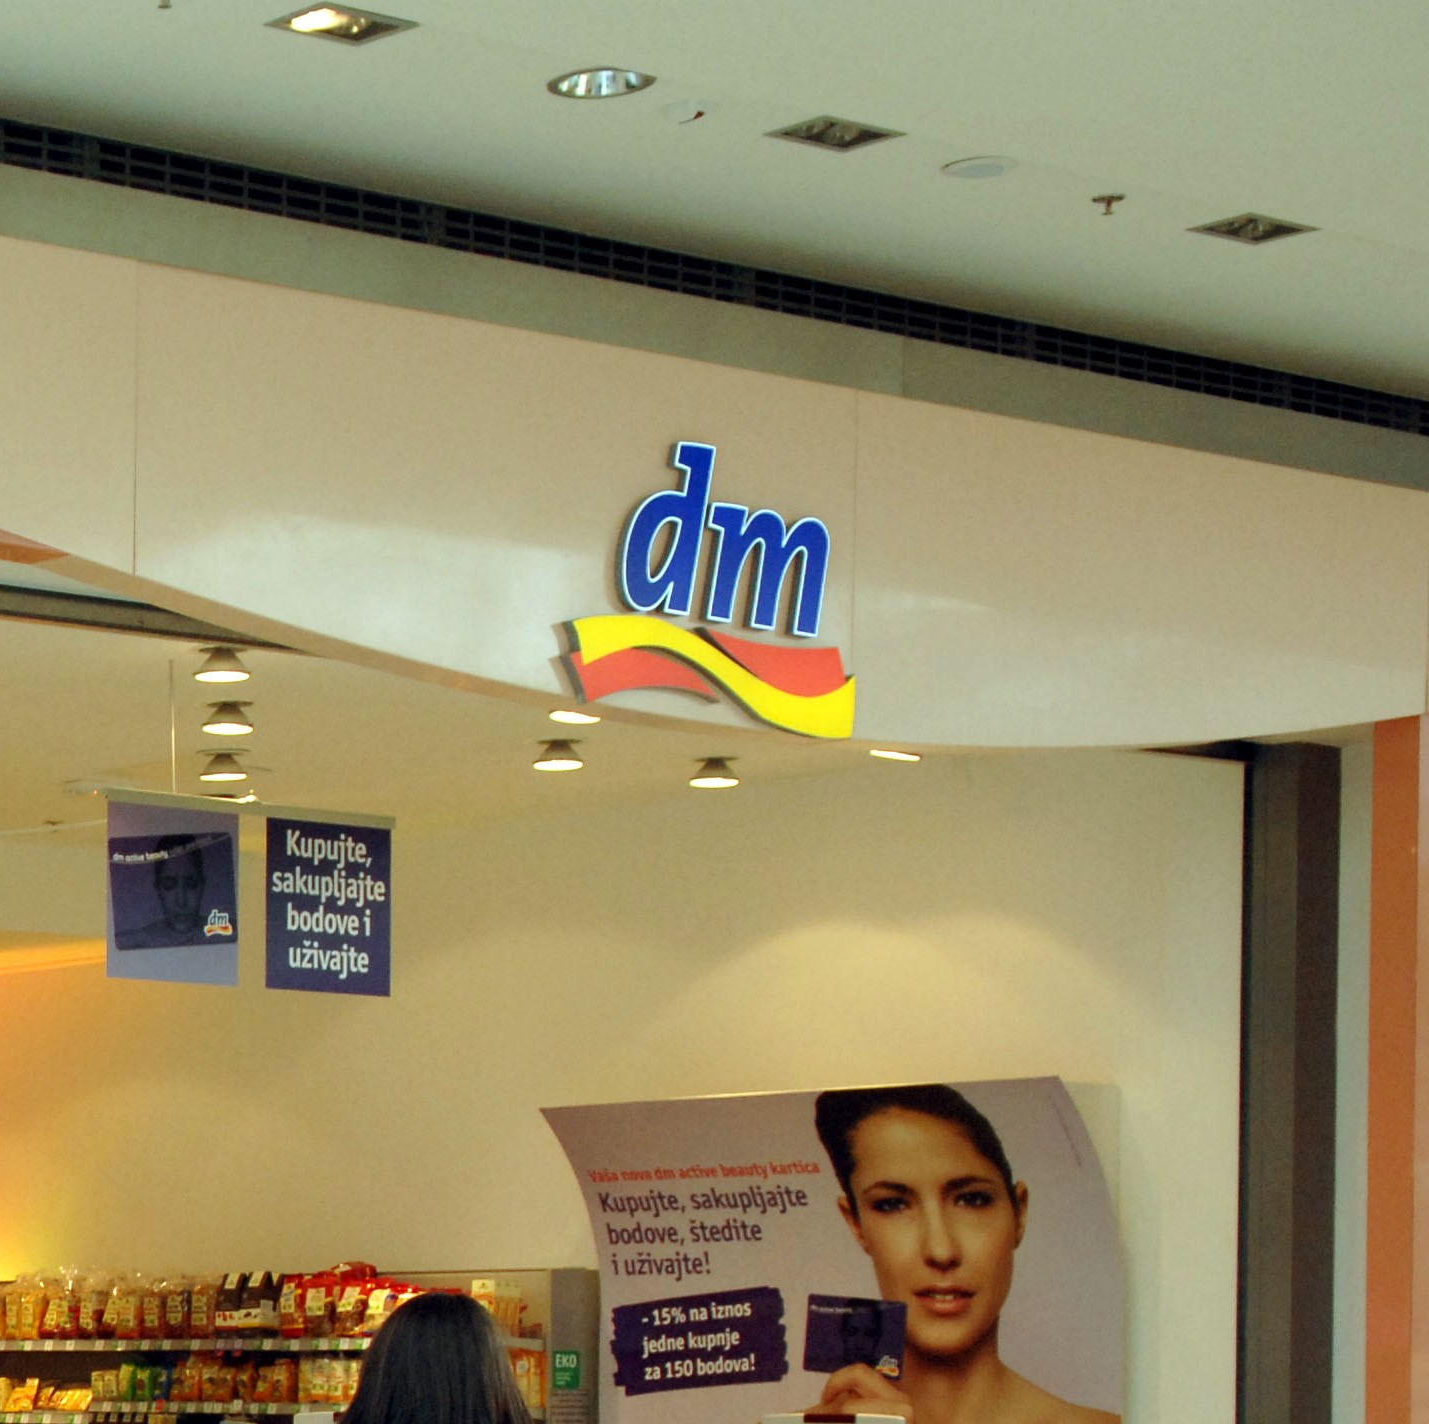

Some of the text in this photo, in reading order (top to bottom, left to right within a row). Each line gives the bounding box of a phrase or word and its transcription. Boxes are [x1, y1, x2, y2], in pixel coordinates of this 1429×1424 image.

[623, 441, 830, 637] dm
[286, 829, 372, 868] Kupujte,
[272, 866, 386, 907] sakupljajte
[287, 902, 371, 937] bodove i
[289, 940, 369, 979] uživajte
[654, 1167, 676, 1180] dm
[679, 1164, 718, 1179] active
[719, 1163, 769, 1180] beauty
[770, 1160, 821, 1175] kartica
[599, 1185, 809, 1217] Kupujte, sakupljajte
[606, 1218, 762, 1246] bodove, štedite
[611, 1251, 711, 1281] i uživajte!
[652, 1306, 686, 1326] 15%
[690, 1307, 708, 1322] na
[711, 1301, 752, 1319] iznos
[642, 1328, 740, 1358] jedne kupnje
[555, 1353, 577, 1369] EKO
[644, 1353, 756, 1381] za 150 bodova!
